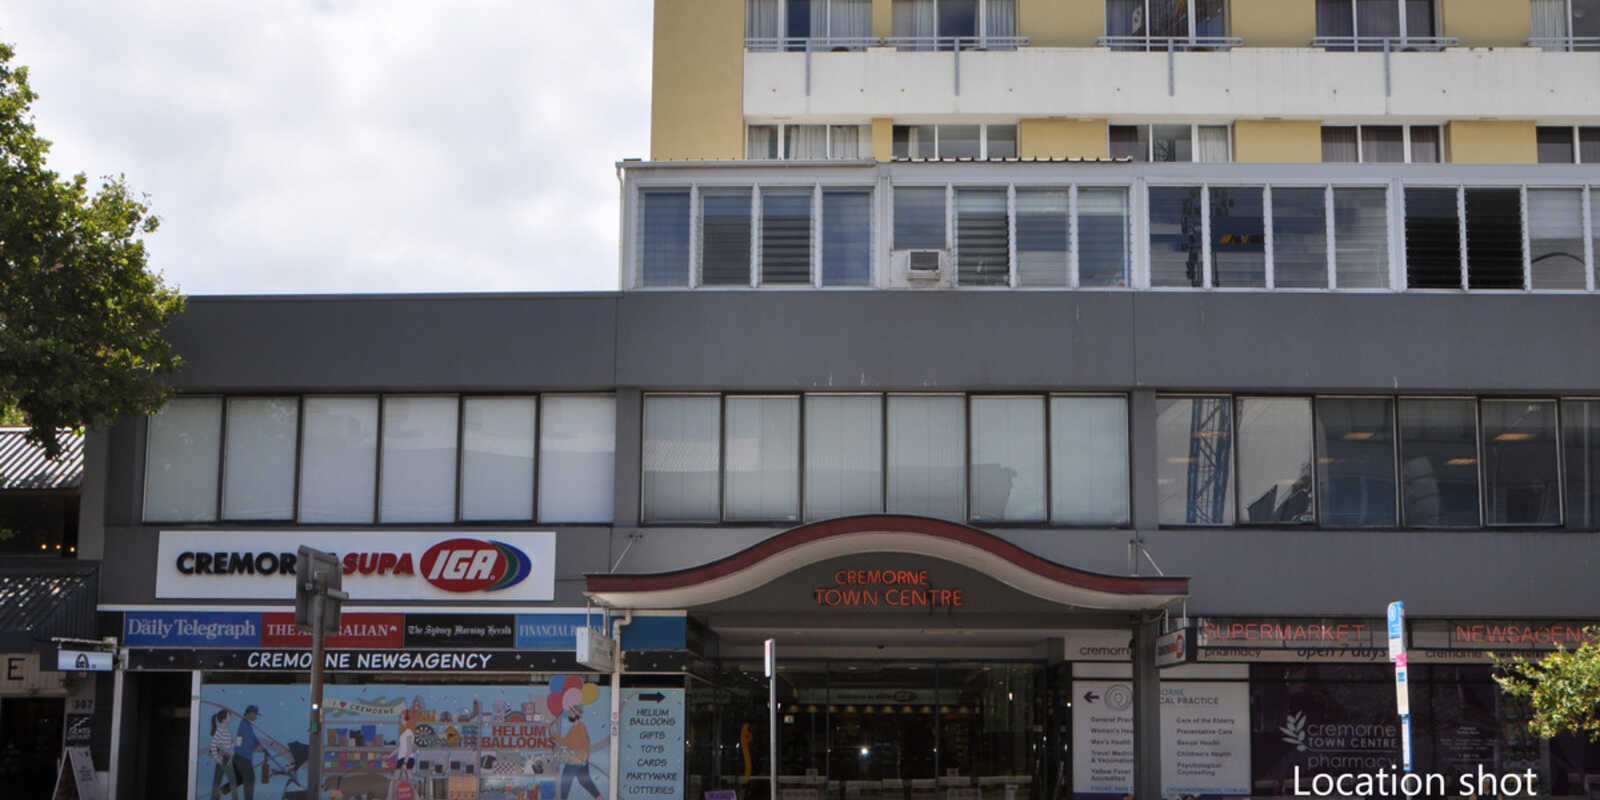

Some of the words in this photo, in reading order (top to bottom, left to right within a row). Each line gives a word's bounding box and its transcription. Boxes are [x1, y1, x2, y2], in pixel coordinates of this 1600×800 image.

[176, 551, 338, 576] CREMOR
[343, 551, 415, 576] SUPA
[428, 549, 498, 580] IGA
[833, 569, 929, 585] CREMORNE
[815, 588, 878, 607] TOWN
[885, 588, 964, 607] CENTRE
[128, 618, 173, 639] Daily
[174, 618, 257, 640] Telegraph
[266, 623, 296, 637] THE
[407, 625, 423, 635] The
[424, 625, 452, 638] Sydney
[454, 625, 486, 637] Morning
[488, 625, 512, 635] Herald
[519, 625, 569, 637] FINANCIAL
[1205, 623, 1365, 641] SUPERMARKET
[1297, 647, 1334, 660] open
[247, 652, 351, 668] CREMONE
[356, 653, 493, 669] NEWSAGENCY
[636, 708, 670, 717] HELIUM
[629, 717, 676, 726] BALLOONS
[492, 725, 547, 737] HELIUM
[639, 731, 666, 740] GIFTS
[1306, 722, 1398, 738] cremorne
[480, 736, 556, 749] BALLOONS
[640, 744, 665, 754] TOYS
[1307, 737, 1345, 748] TOWN
[1350, 738, 1399, 748] CENTRE
[636, 758, 668, 768] CARDS
[627, 772, 678, 782] PARTYWARE
[629, 785, 675, 795] LOTTERIES
